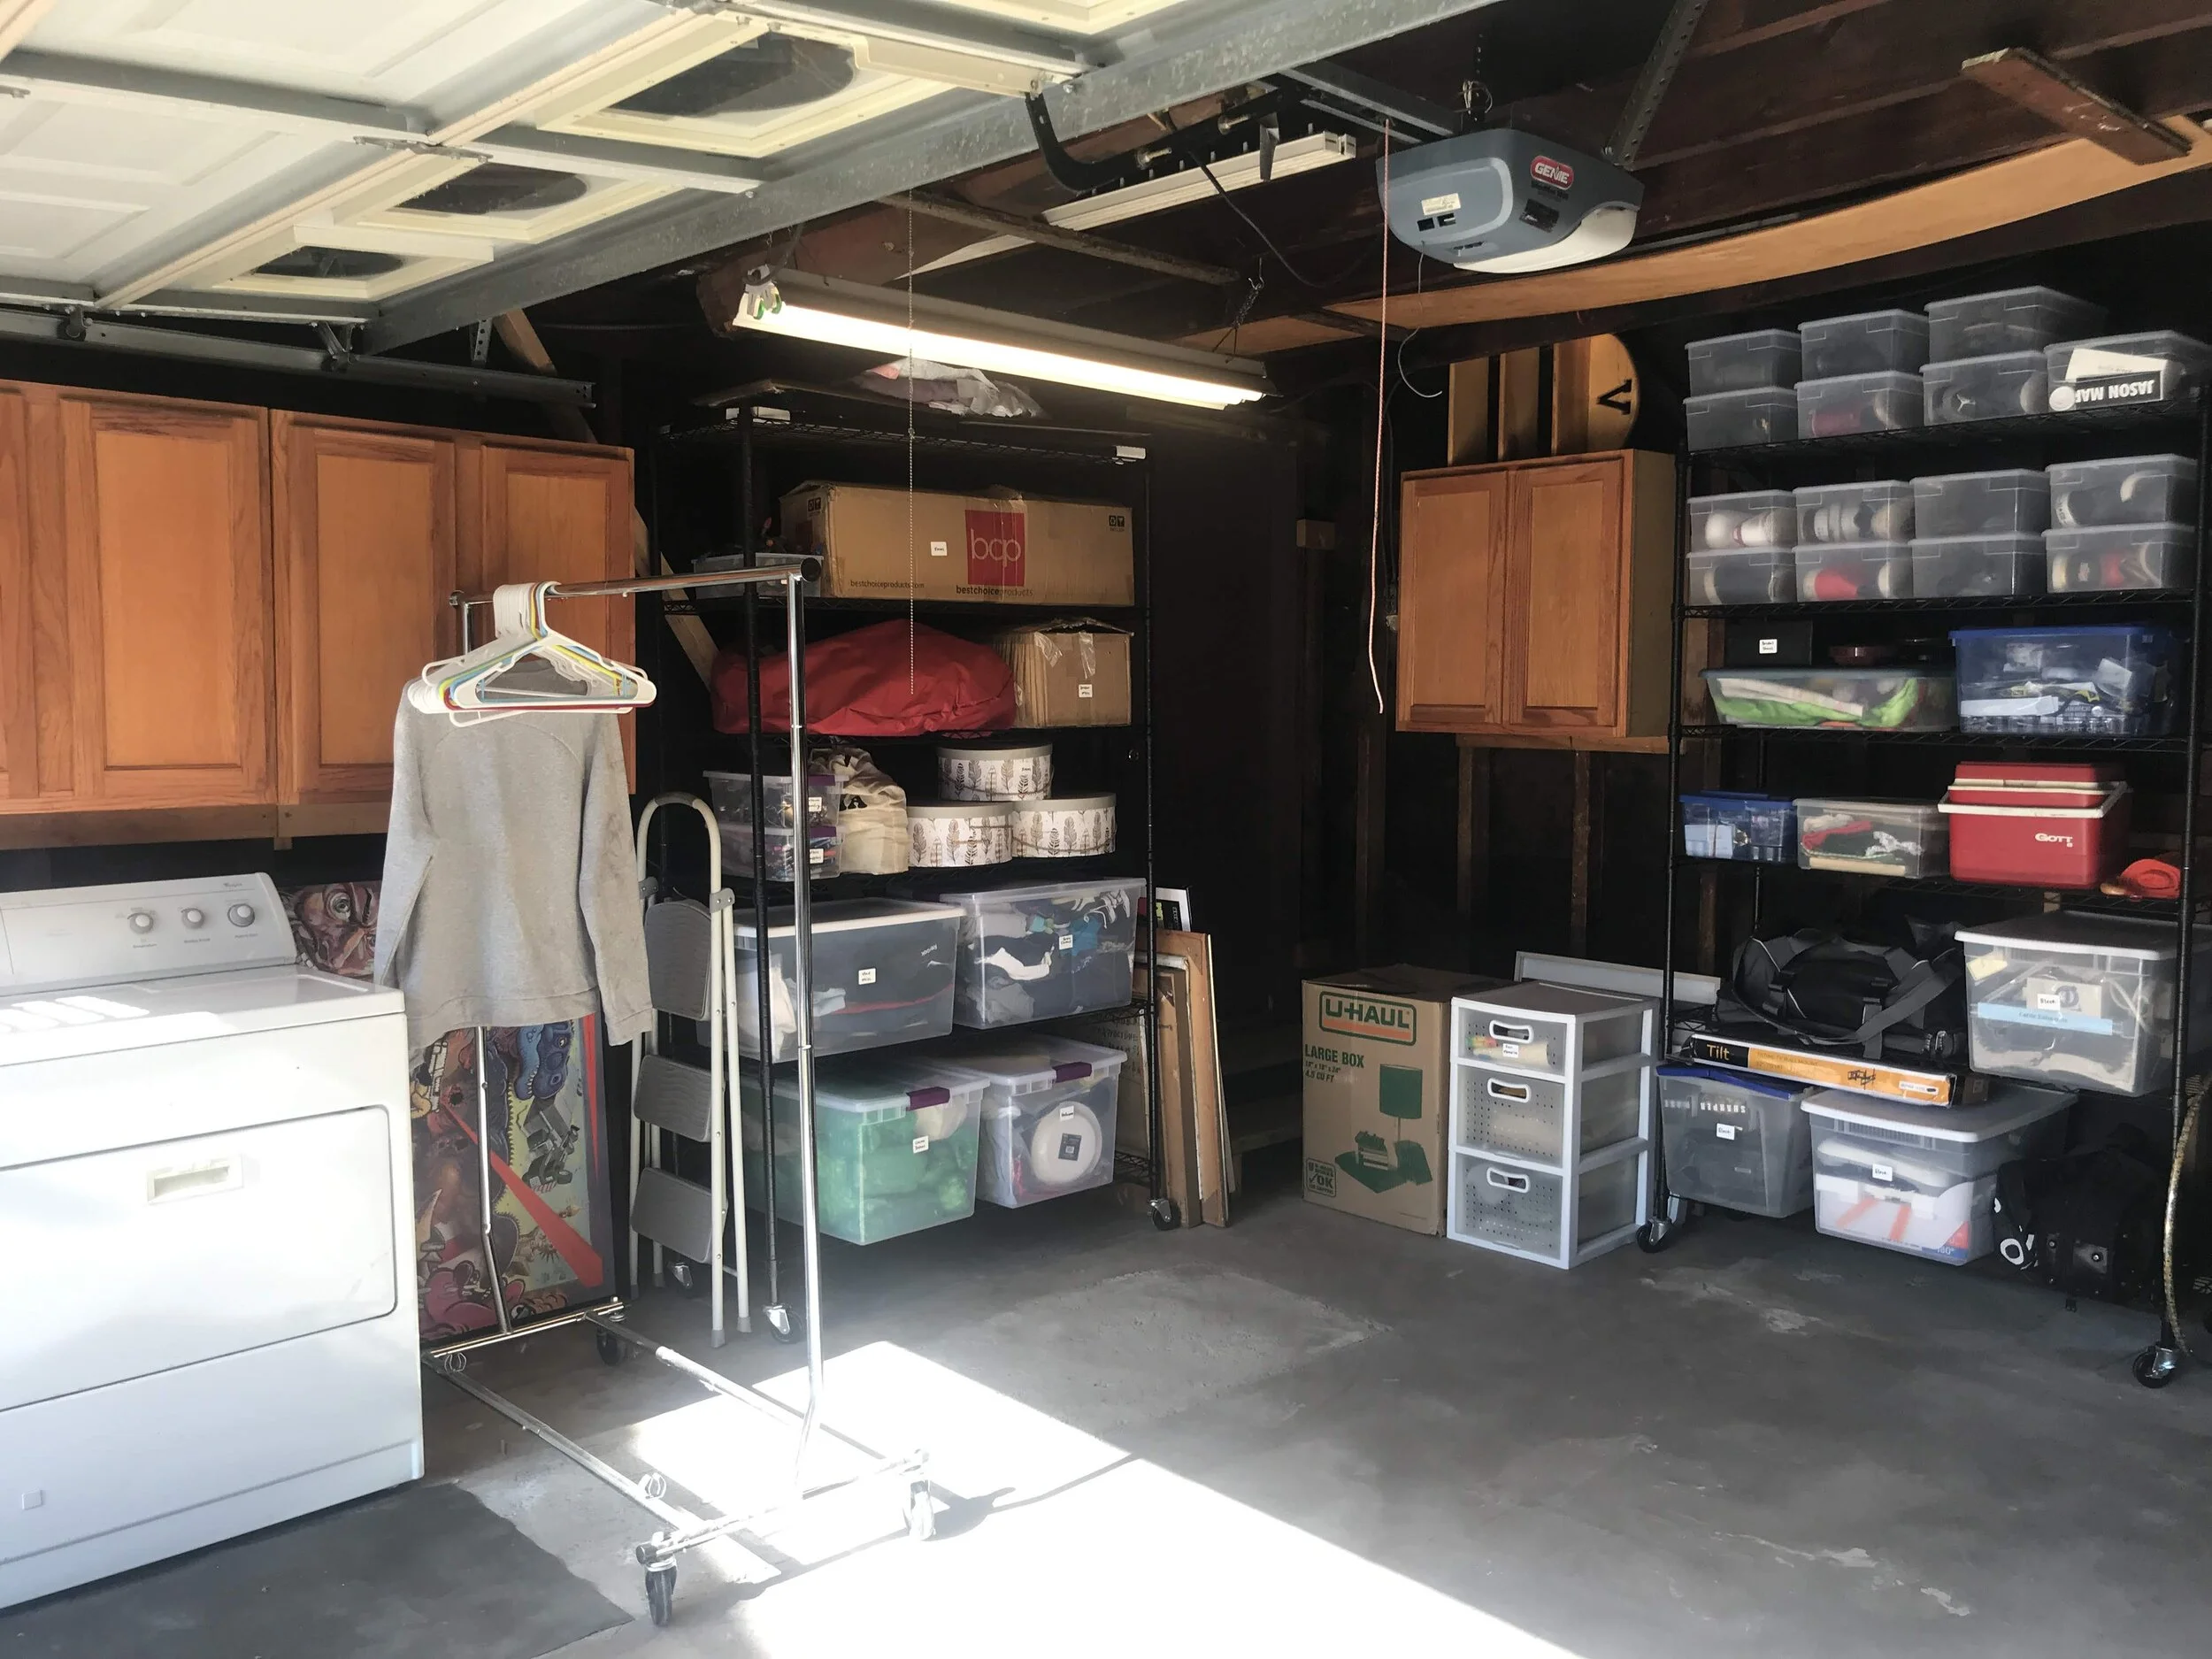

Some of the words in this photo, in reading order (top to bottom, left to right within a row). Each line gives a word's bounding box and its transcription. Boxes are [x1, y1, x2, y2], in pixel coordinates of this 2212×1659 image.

[1534, 162, 1570, 184] GENIE
[2108, 380, 2155, 399] JASON
[1325, 998, 1409, 1029] U-HAUL
[1305, 1044, 1339, 1063] LARGE
[1341, 1051, 1364, 1069] BOX
[1706, 1044, 1730, 1061] Tilt
